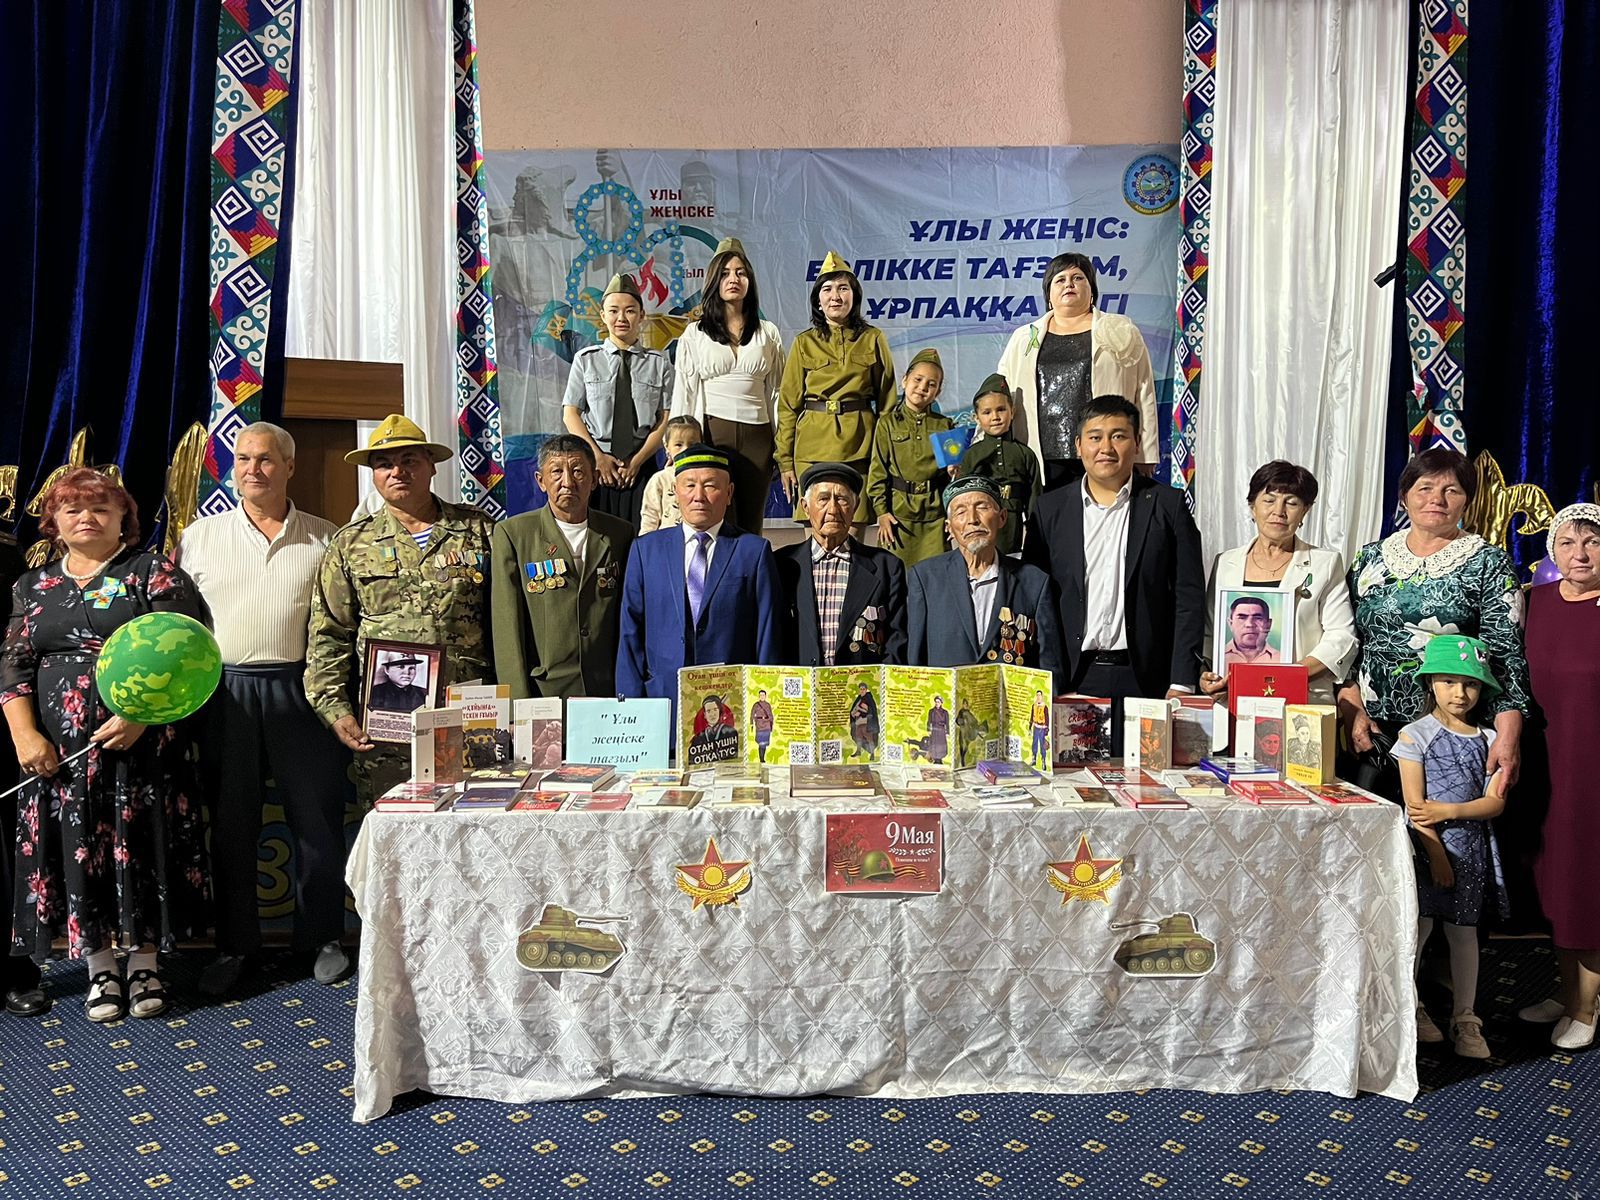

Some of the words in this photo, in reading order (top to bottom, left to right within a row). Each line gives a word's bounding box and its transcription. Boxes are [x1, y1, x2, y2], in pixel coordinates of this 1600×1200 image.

[649, 189, 682, 201] ҰЛЫ
[650, 206, 715, 219] ЖЕҢІСКЕ
[909, 218, 992, 242] ҰЛЫ
[999, 217, 1130, 243] ЖЕҢІС:
[682, 268, 704, 279] ЫЛ
[806, 258, 956, 282] ЕЛІККЕ
[966, 255, 1128, 281] ТАҒЗМ,
[866, 295, 1039, 322] ҰРПАҚҚА
[592, 732, 645, 746] жеңіске
[689, 742, 714, 755] ОТАН
[715, 736, 738, 748] ҮШІН
[885, 821, 900, 848] 9
[901, 826, 934, 844] Мая
